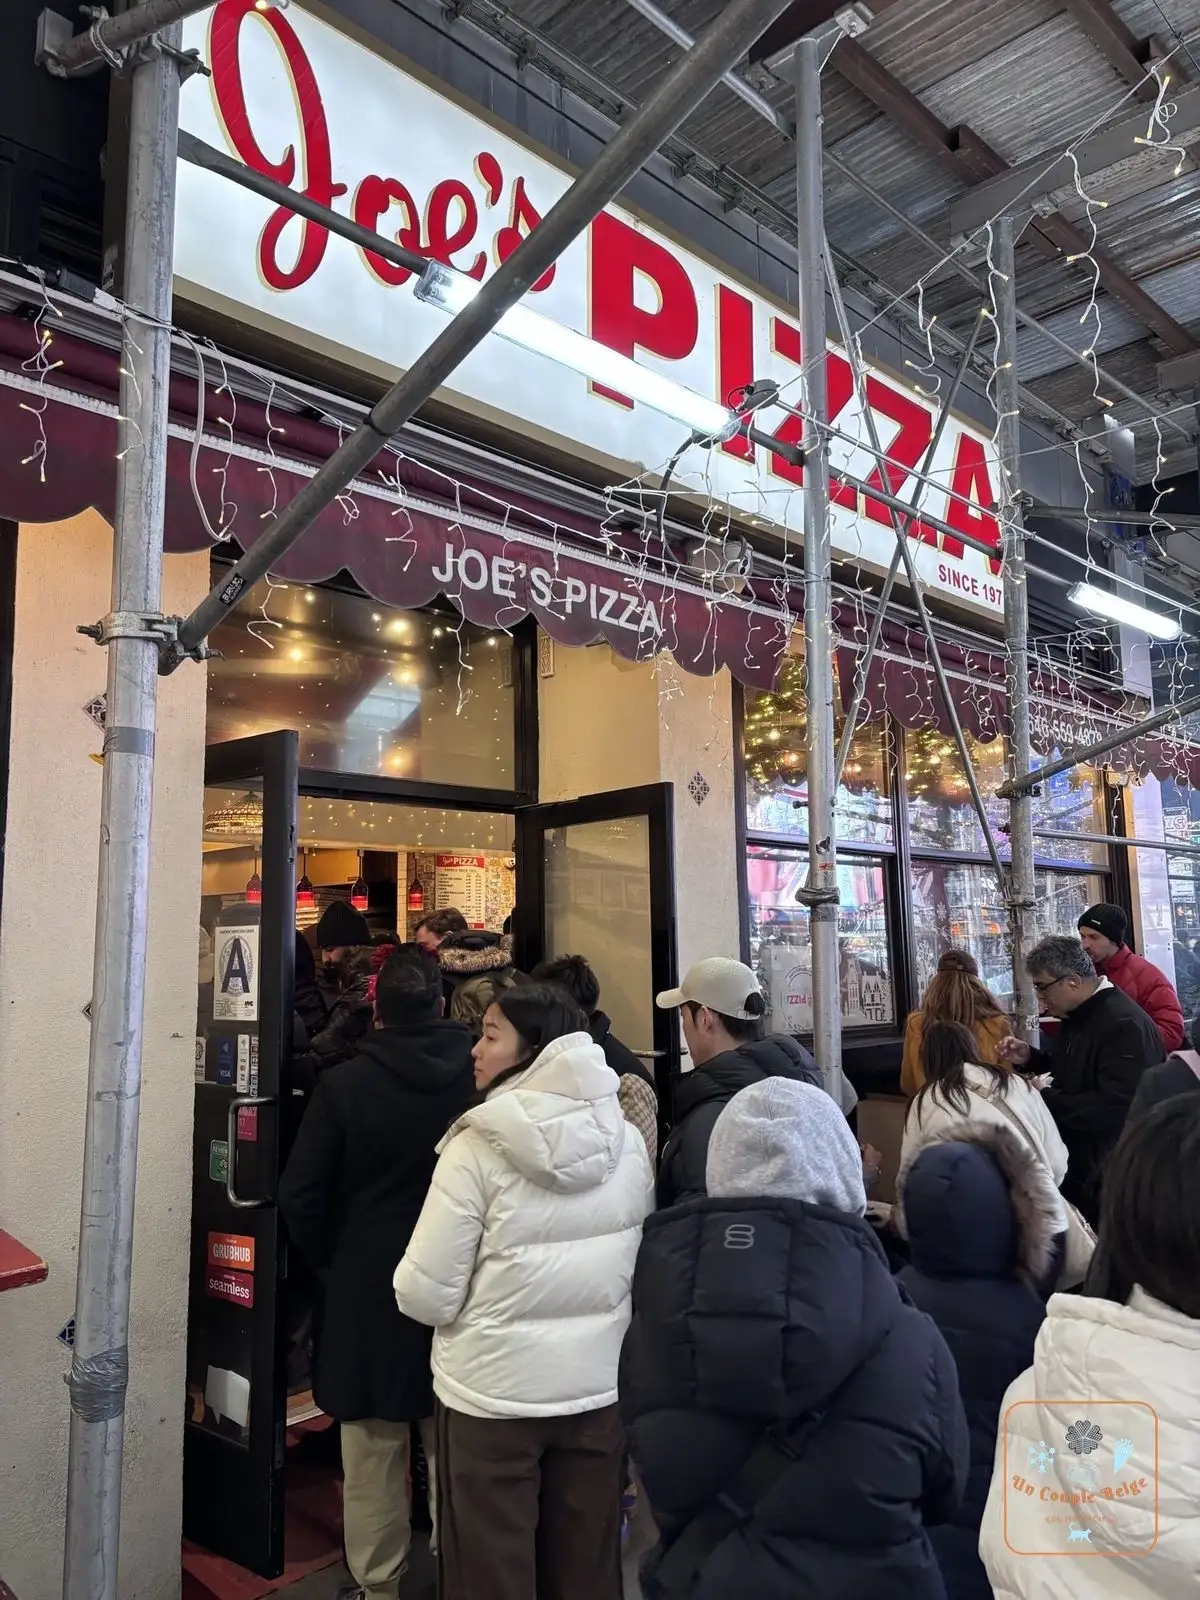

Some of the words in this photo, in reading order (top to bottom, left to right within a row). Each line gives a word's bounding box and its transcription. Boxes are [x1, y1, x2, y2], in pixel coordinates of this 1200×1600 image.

[206, 0, 556, 292] Joe's
[587, 209, 1003, 577] PIZZA
[431, 543, 553, 607] JOE'S
[566, 577, 664, 636] PIZZA
[938, 564, 979, 597] SINCE
[983, 584, 1003, 606] 197
[453, 857, 478, 866] PIZZA
[221, 938, 250, 993] A
[219, 1069, 231, 1078] VISA
[212, 1243, 251, 1262] GRUBHUB
[209, 1278, 250, 1299] seamless
